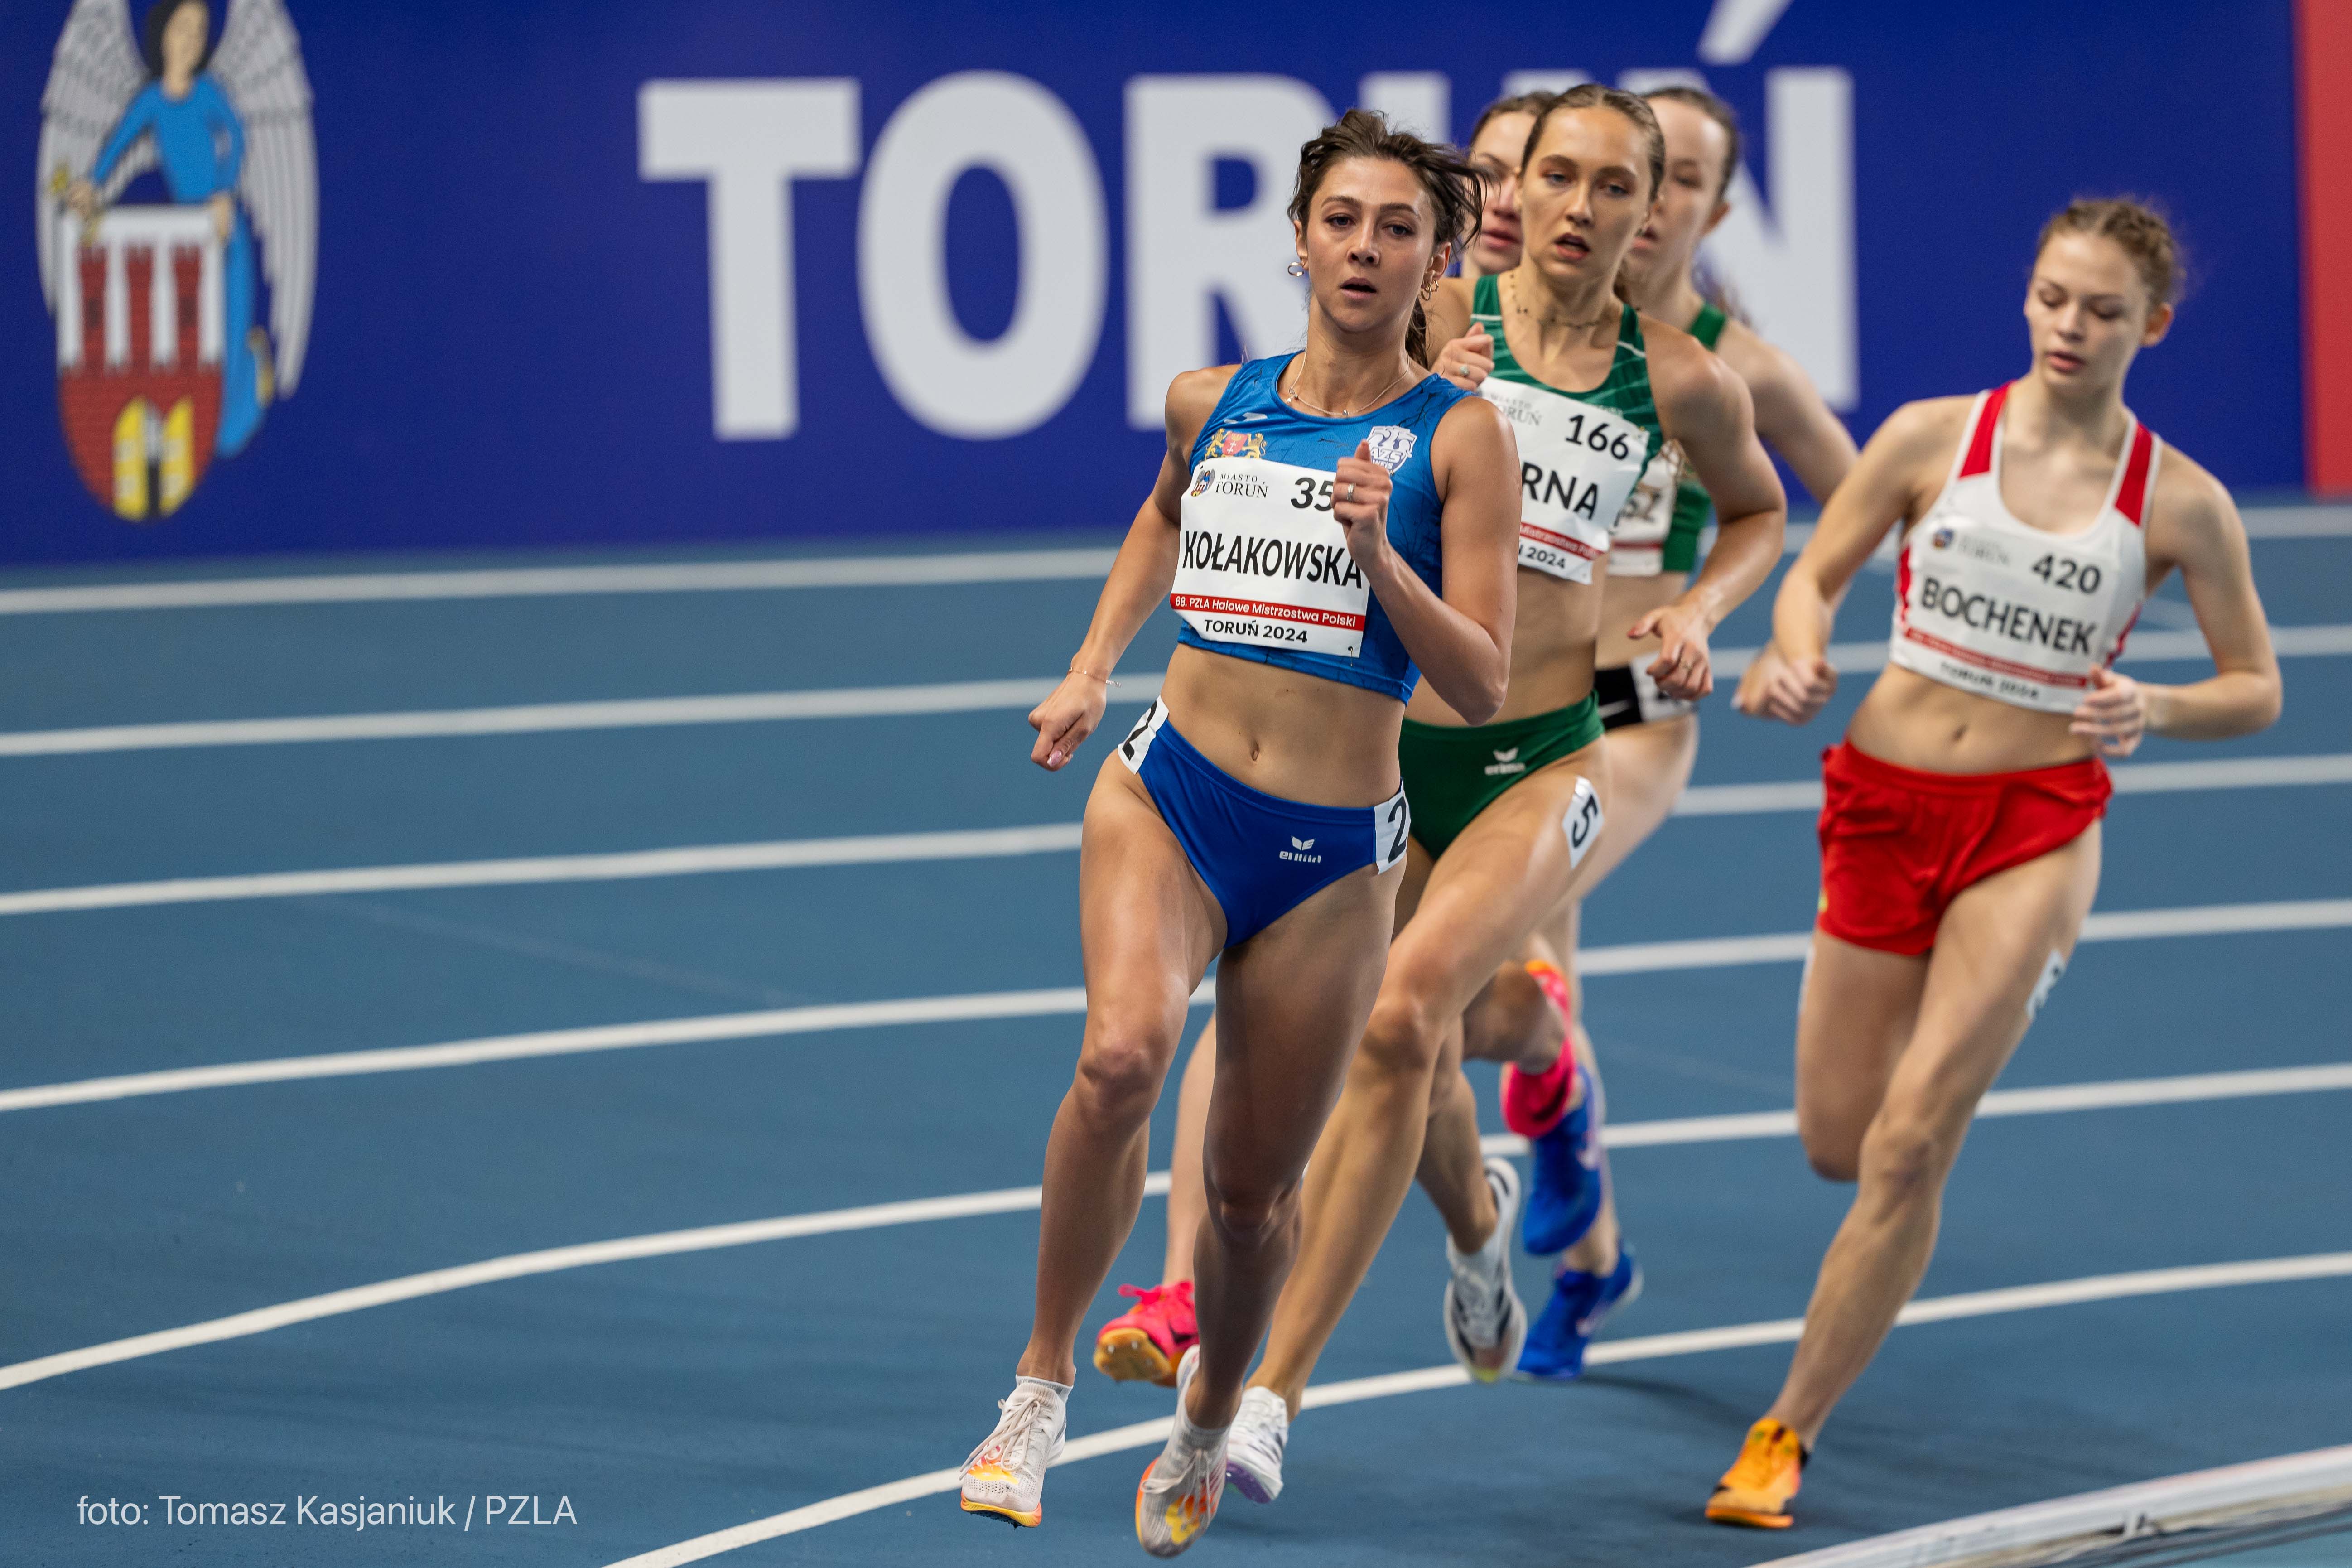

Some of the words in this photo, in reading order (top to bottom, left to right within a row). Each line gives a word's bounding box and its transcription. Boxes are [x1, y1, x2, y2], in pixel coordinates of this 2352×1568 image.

[1565, 414, 1629, 460] 166
[1215, 481, 1268, 499] TORUŃ
[1220, 473, 1258, 482] MIASTO
[1521, 462, 1599, 520] RNA
[1182, 531, 1362, 589] KOŁAKOWSKA
[1526, 547, 1565, 568] 2024
[2032, 554, 2101, 594] 420
[1175, 596, 1187, 608] 68.
[1189, 597, 1210, 609] PZLA
[1212, 599, 1249, 613] Halowe
[1252, 603, 1319, 622] Mistrzostwa
[1322, 613, 1356, 627] Polski
[1204, 619, 1259, 637] TORUŃ
[1263, 625, 1308, 643] 2024
[1920, 577, 2097, 653] BOCHENEK
[1388, 796, 1407, 863] 2
[1572, 794, 1598, 849] 5
